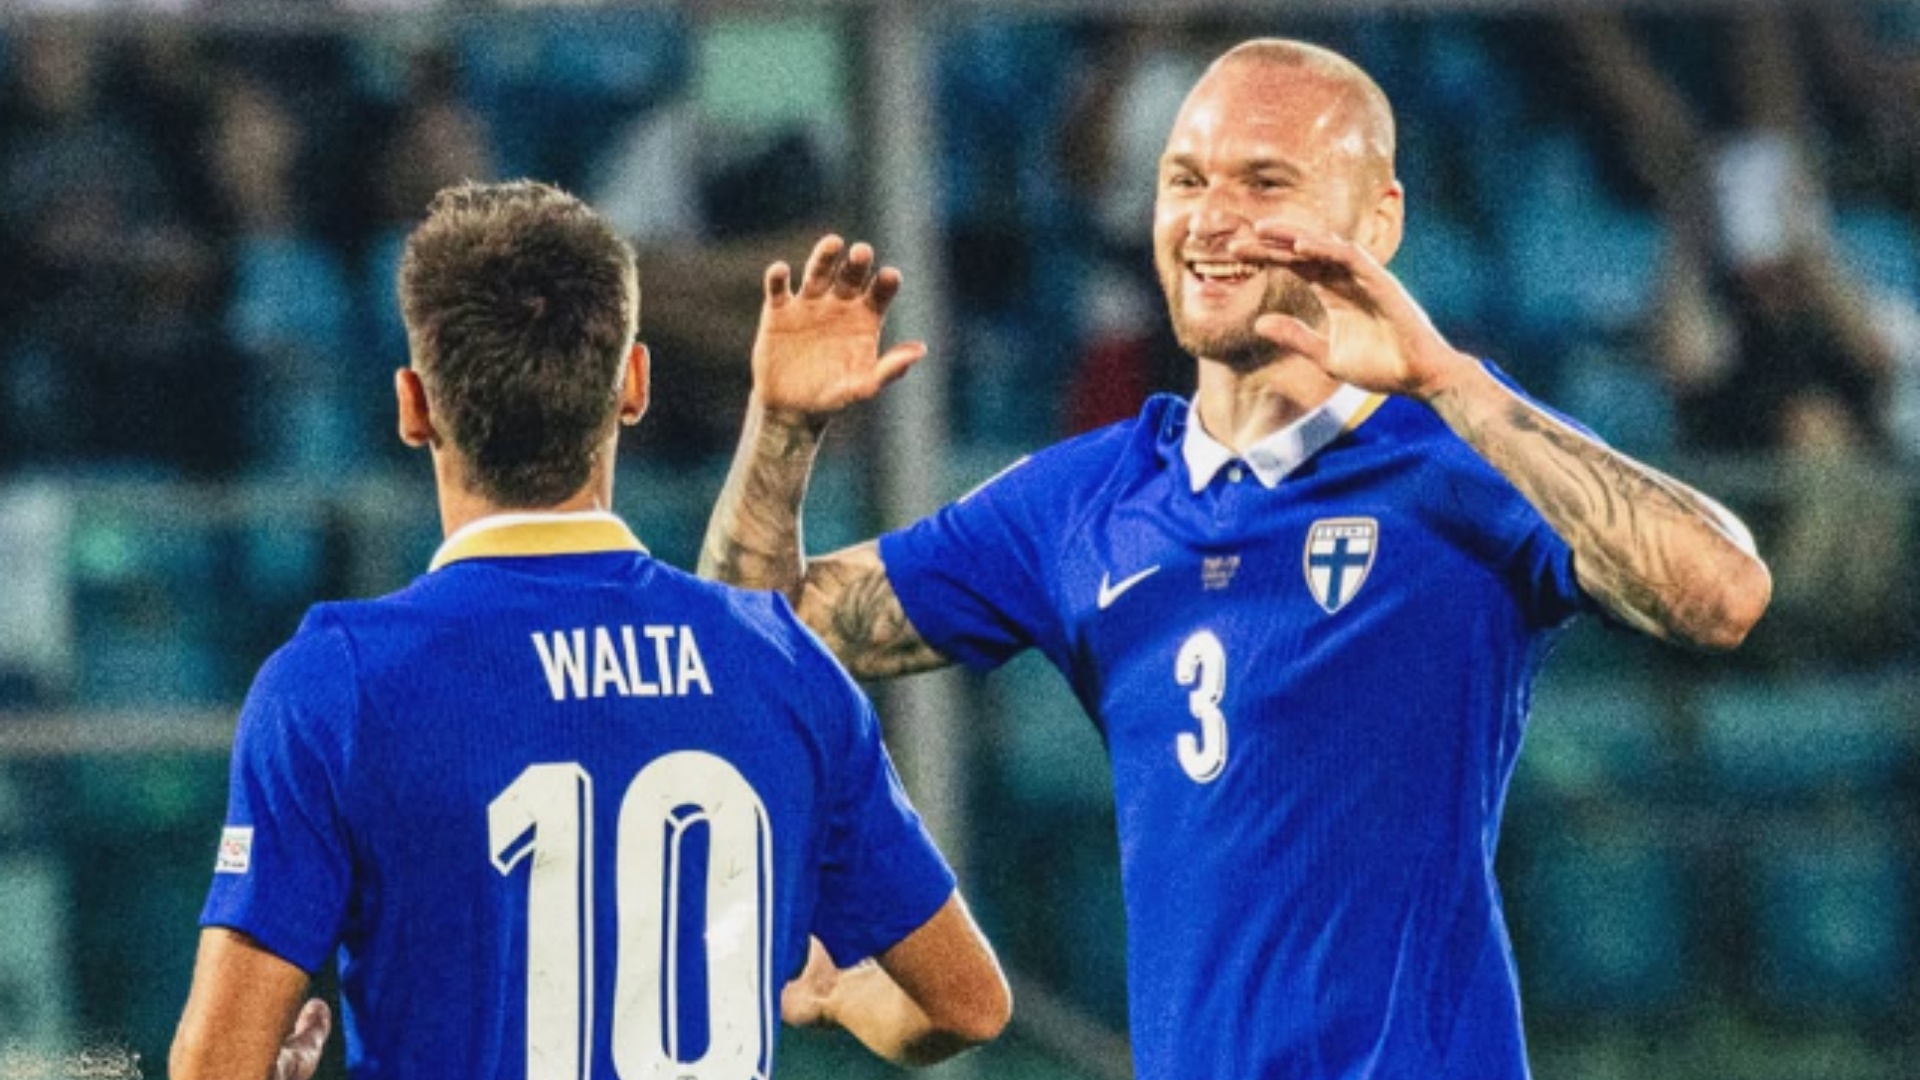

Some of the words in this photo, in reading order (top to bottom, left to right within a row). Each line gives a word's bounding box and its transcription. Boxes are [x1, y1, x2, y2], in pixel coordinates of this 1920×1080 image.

[532, 626, 712, 700] WALTA
[1176, 630, 1228, 783] 3
[488, 751, 773, 1080] 10
